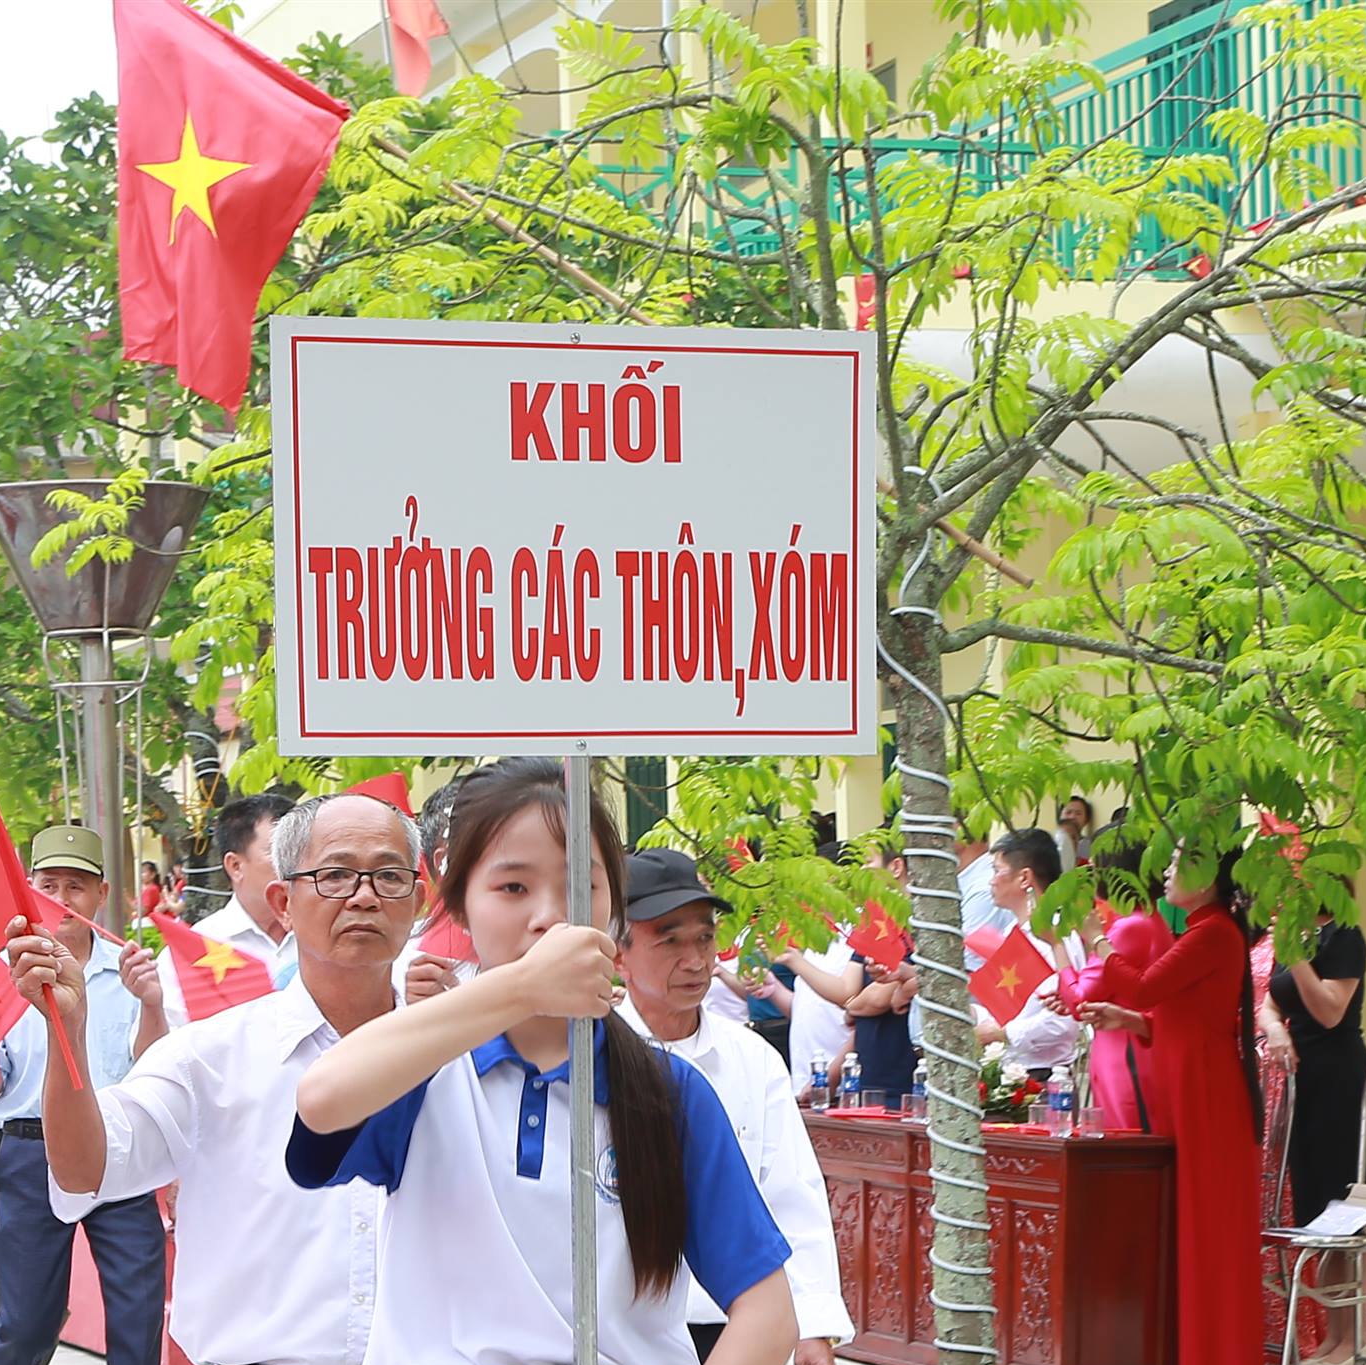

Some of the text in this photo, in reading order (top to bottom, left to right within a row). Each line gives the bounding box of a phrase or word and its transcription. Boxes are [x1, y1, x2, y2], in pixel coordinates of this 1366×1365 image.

[509, 360, 682, 464] KHỐI
[308, 495, 495, 682] TRƯỞNG
[510, 524, 601, 683] CÁC
